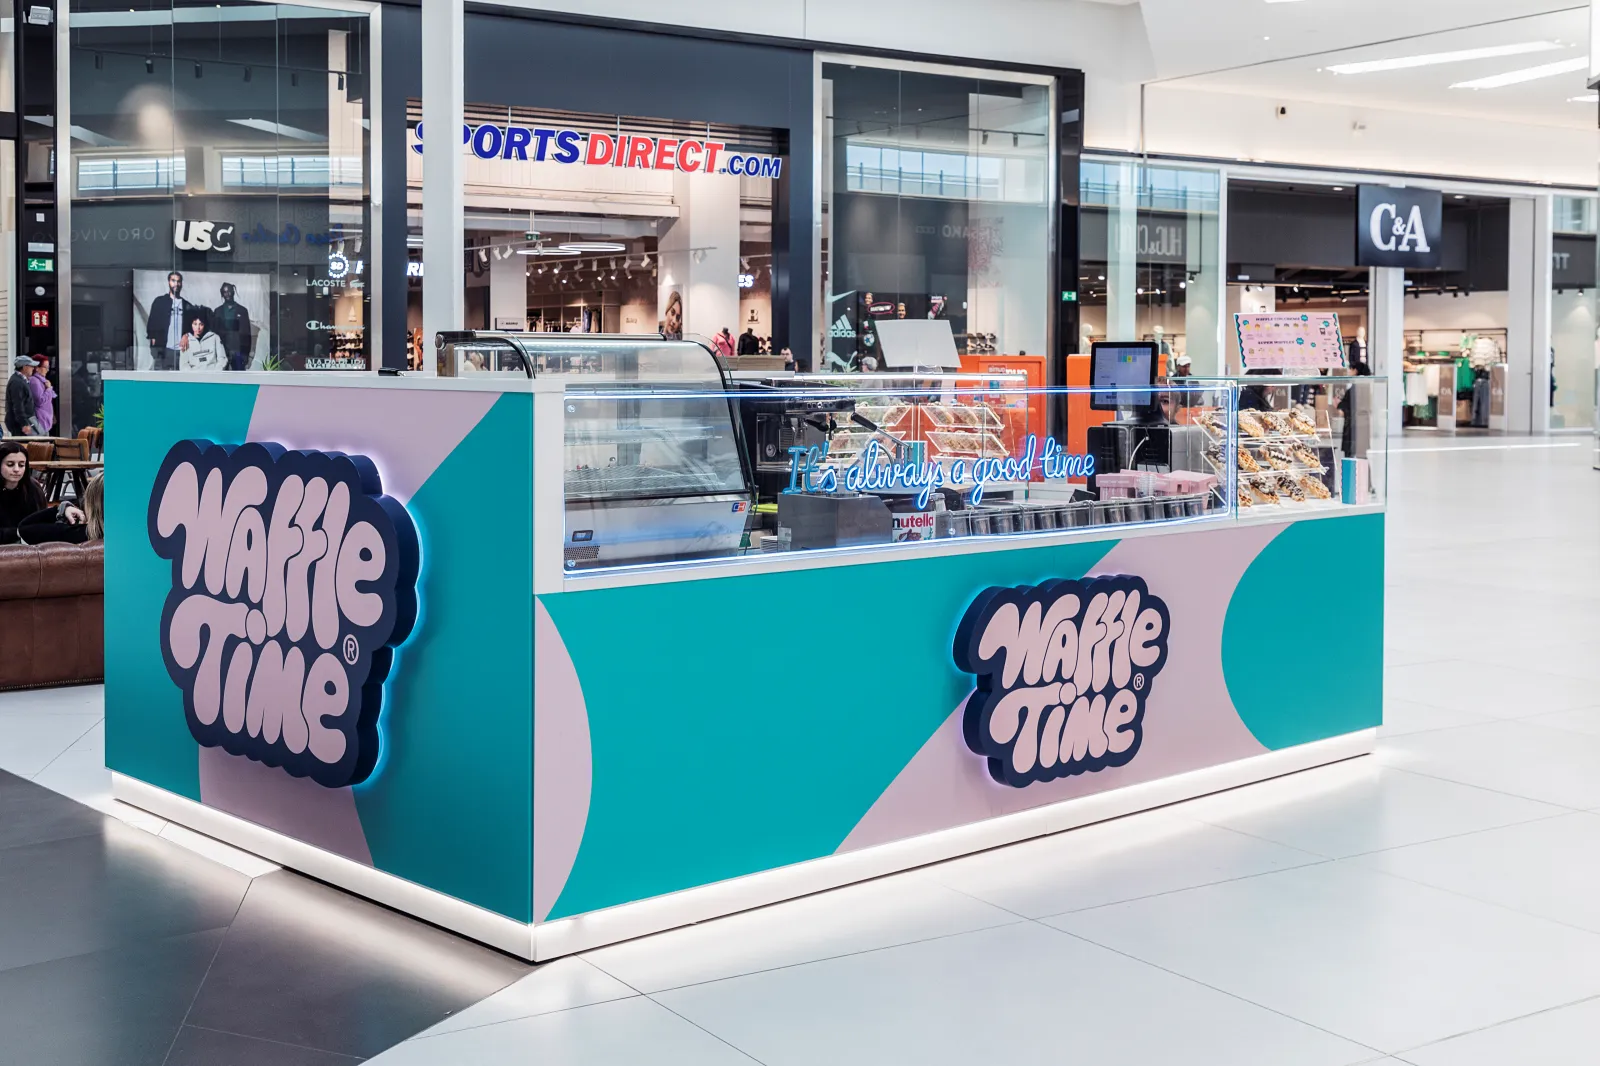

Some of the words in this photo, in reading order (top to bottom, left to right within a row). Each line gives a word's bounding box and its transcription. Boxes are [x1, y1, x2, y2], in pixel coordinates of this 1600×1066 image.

[411, 121, 783, 180] ORTSDIRECT.COM
[174, 220, 234, 252] USC
[1369, 202, 1431, 253] C&A
[306, 279, 346, 288] LACOSTE
[828, 328, 856, 338] adidas
[782, 441, 837, 495] It's
[845, 439, 945, 510] always
[950, 459, 966, 484] a
[972, 433, 1037, 506] good
[1040, 436, 1096, 479] time
[892, 512, 934, 528] nutella
